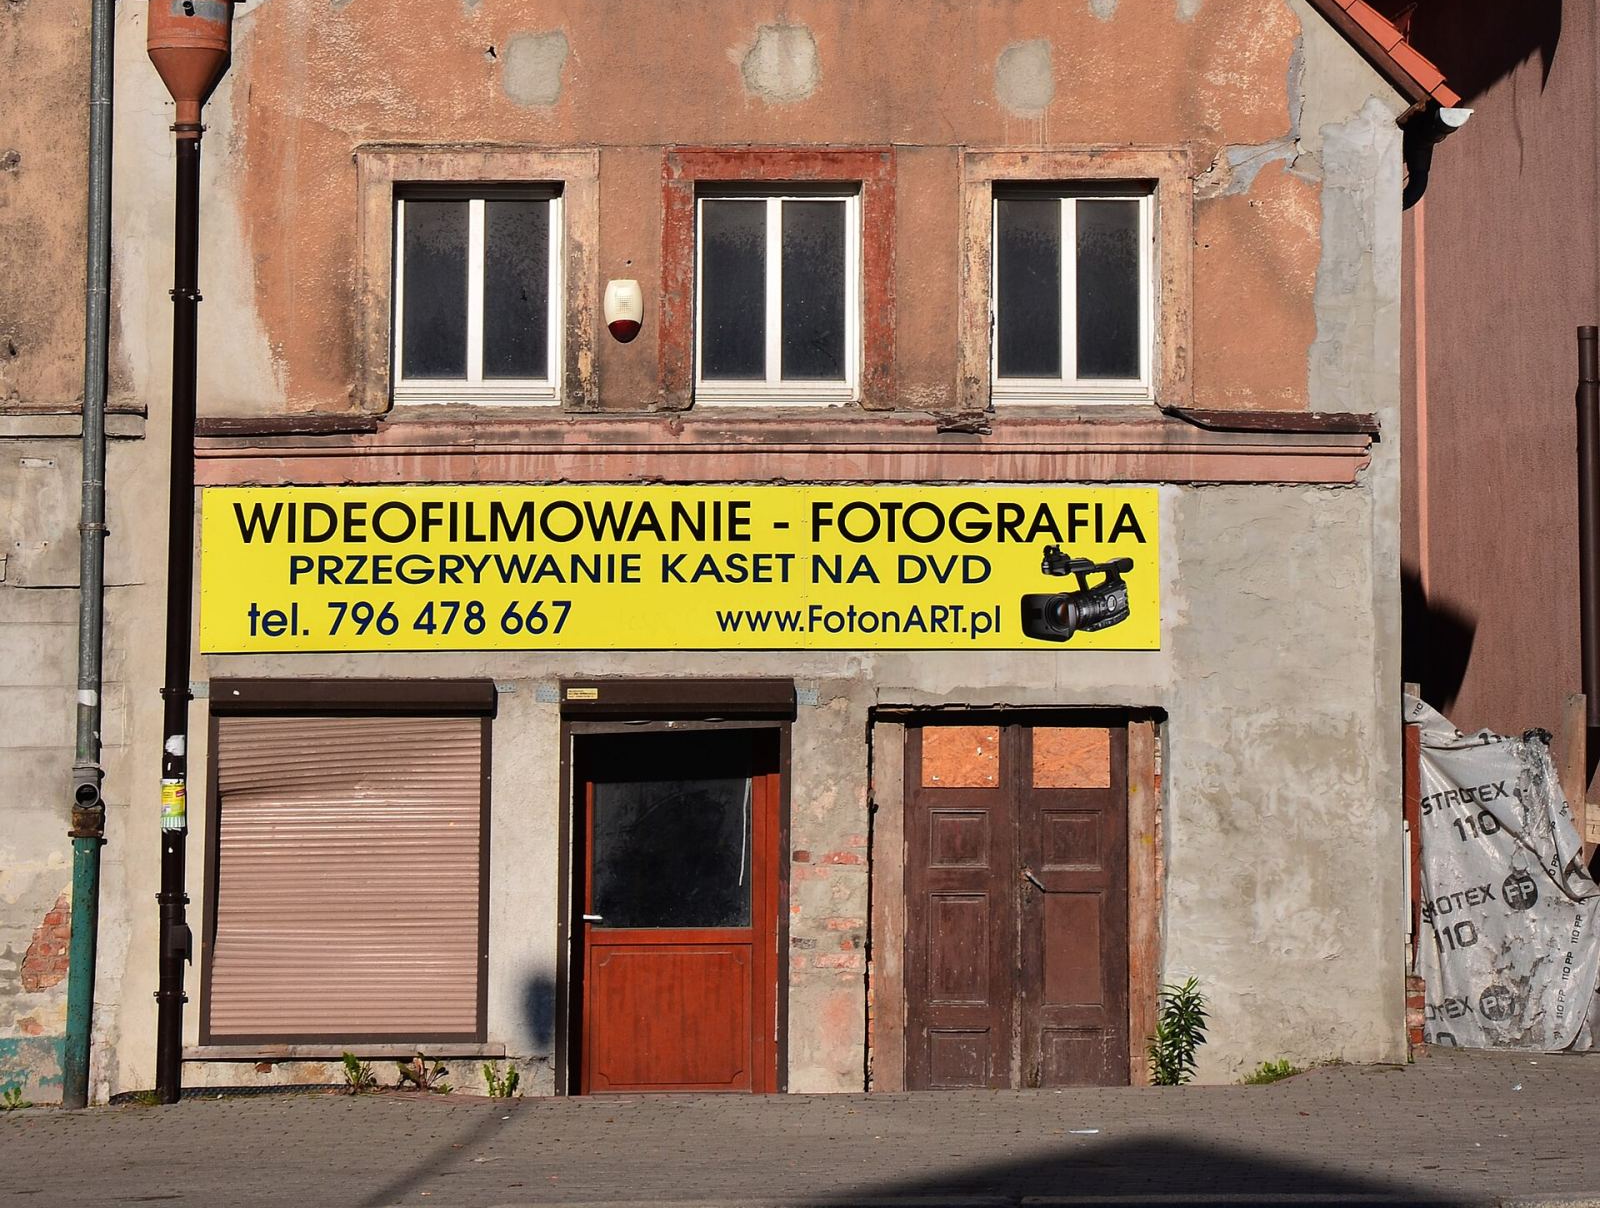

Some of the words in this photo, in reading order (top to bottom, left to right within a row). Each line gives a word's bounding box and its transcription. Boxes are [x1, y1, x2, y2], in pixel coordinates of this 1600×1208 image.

[233, 501, 751, 544] WIDEOFILMOWANIE
[773, 521, 790, 529] -
[811, 501, 1147, 544] FOTOGRAFIA
[289, 553, 642, 585] PRZEGRYWANIE
[661, 553, 796, 584] KASET
[812, 554, 881, 584] NA
[897, 554, 992, 584] DVD
[247, 602, 309, 637] tel.
[328, 600, 399, 636] 796
[412, 600, 486, 636] 478
[500, 600, 572, 635] 667
[715, 604, 1001, 640] www.FotonART.pl
[1421, 780, 1509, 816] STROTEX
[1453, 809, 1501, 842] 110
